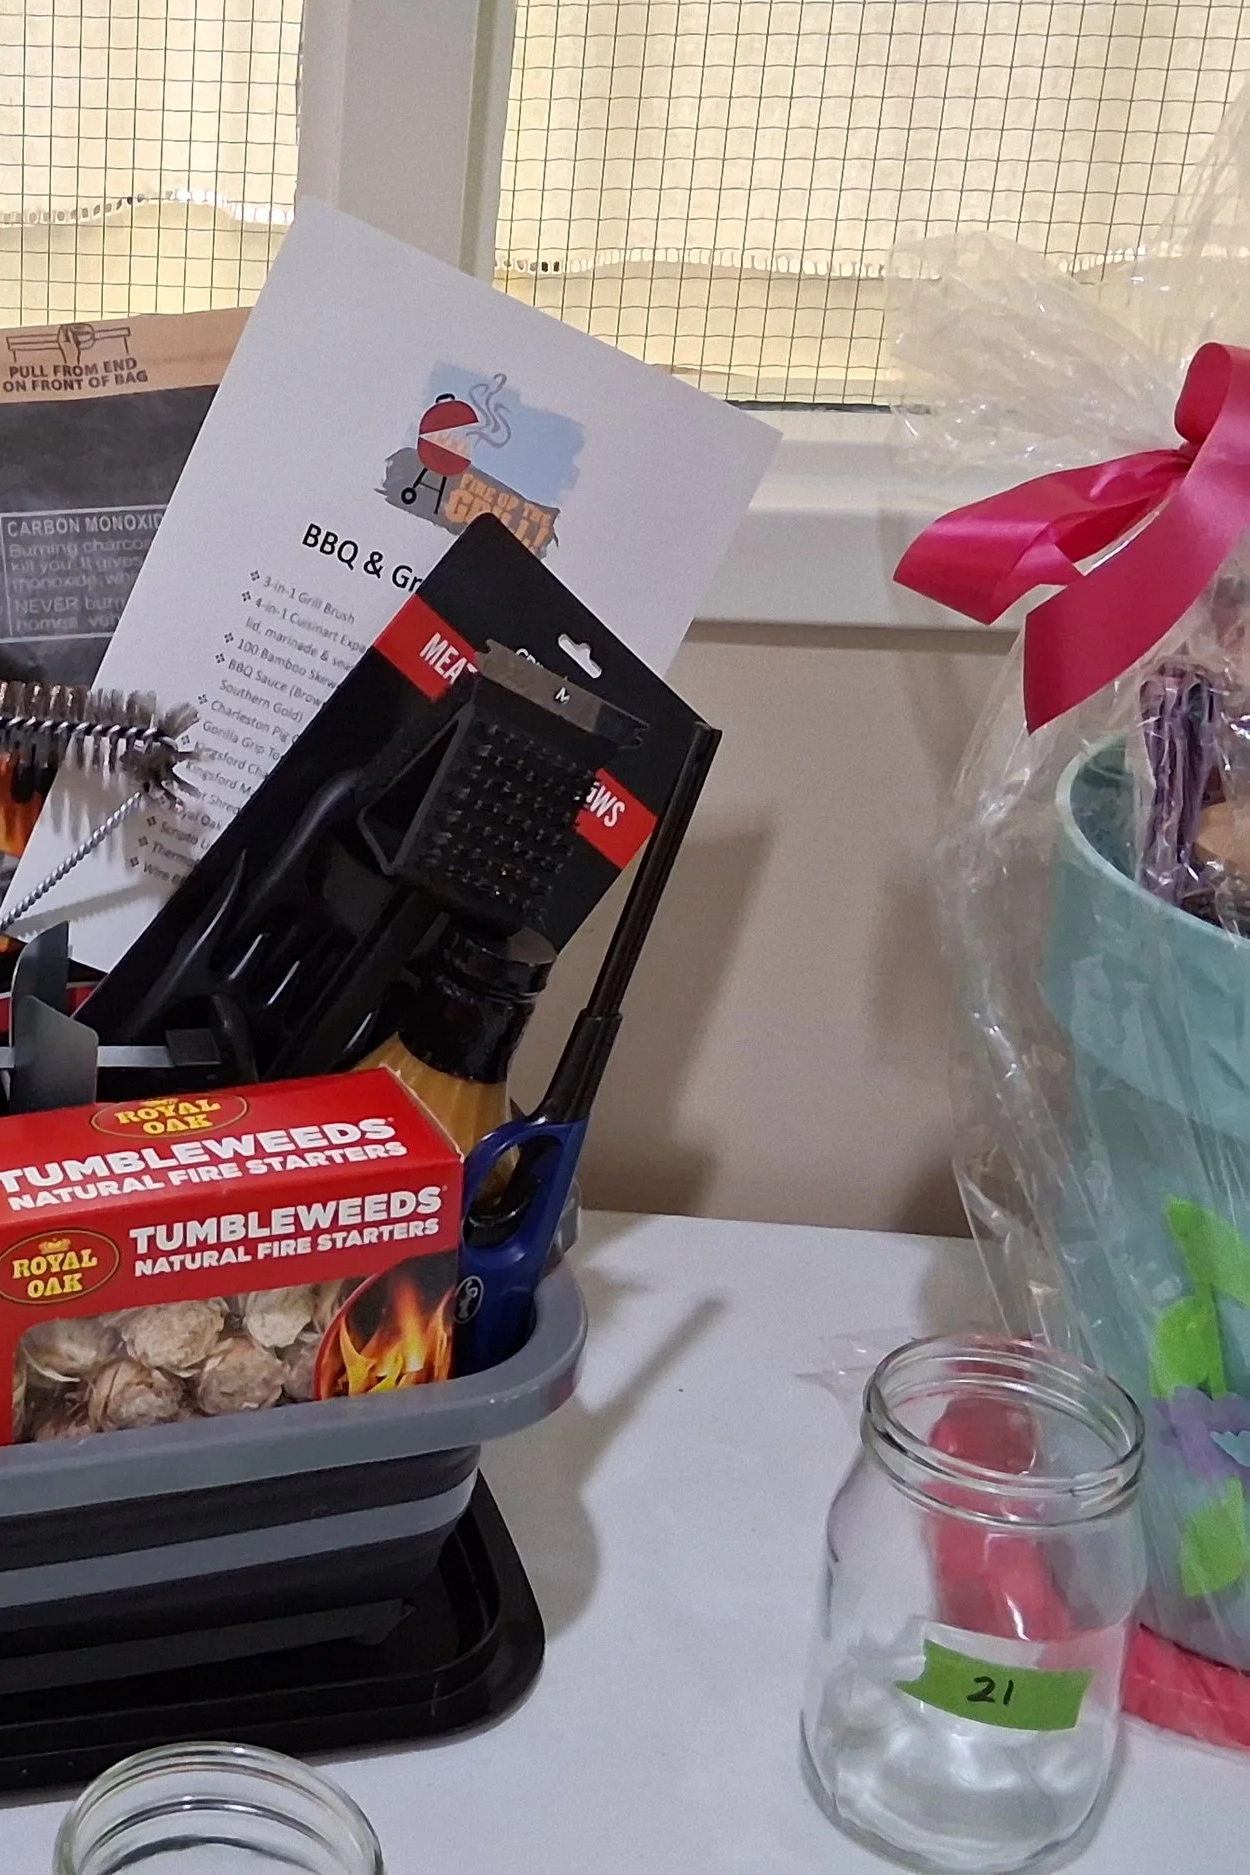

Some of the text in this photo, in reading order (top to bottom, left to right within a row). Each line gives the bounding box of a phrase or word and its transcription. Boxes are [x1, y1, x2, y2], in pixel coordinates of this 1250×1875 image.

[2, 370, 149, 393] ON FRONT OF BAG
[9, 357, 137, 379] PULL FROM END
[7, 518, 80, 537] CARBON
[9, 541, 79, 559] Burning
[11, 558, 35, 573] kill
[302, 522, 422, 593] BBQ & Gr
[15, 596, 79, 615] NEVER
[263, 575, 355, 625] 3-in-1 Grill Brush
[255, 597, 287, 620] 4-in-1
[289, 612, 339, 644] Cuisinart
[237, 638, 260, 656] 100
[260, 646, 307, 678] Bamboo
[265, 627, 319, 658] marinade
[320, 650, 329, 662] &
[419, 632, 479, 685] MEA
[228, 657, 253, 679] BBQ
[254, 669, 289, 693] Sauce
[219, 679, 304, 724] Southern Gold)
[202, 720, 239, 744] Gorilla
[240, 735, 266, 757] Grip
[211, 699, 270, 734] Charleston
[271, 725, 291, 744] Pig
[185, 759, 238, 790] Kingsford
[201, 813, 223, 831] Oak
[114, 1099, 222, 1125] ROYAL
[142, 1114, 213, 1135] OAK
[6, 1140, 408, 1213] NATURAL FIRE STARTERS
[128, 1184, 444, 1256] TUMBLEWEEDS
[10, 1247, 99, 1280] ROYAL
[133, 1217, 441, 1279] NATURAL FIRE STARTERS
[25, 1272, 84, 1299] OAK
[965, 1675, 1015, 1706] 21
